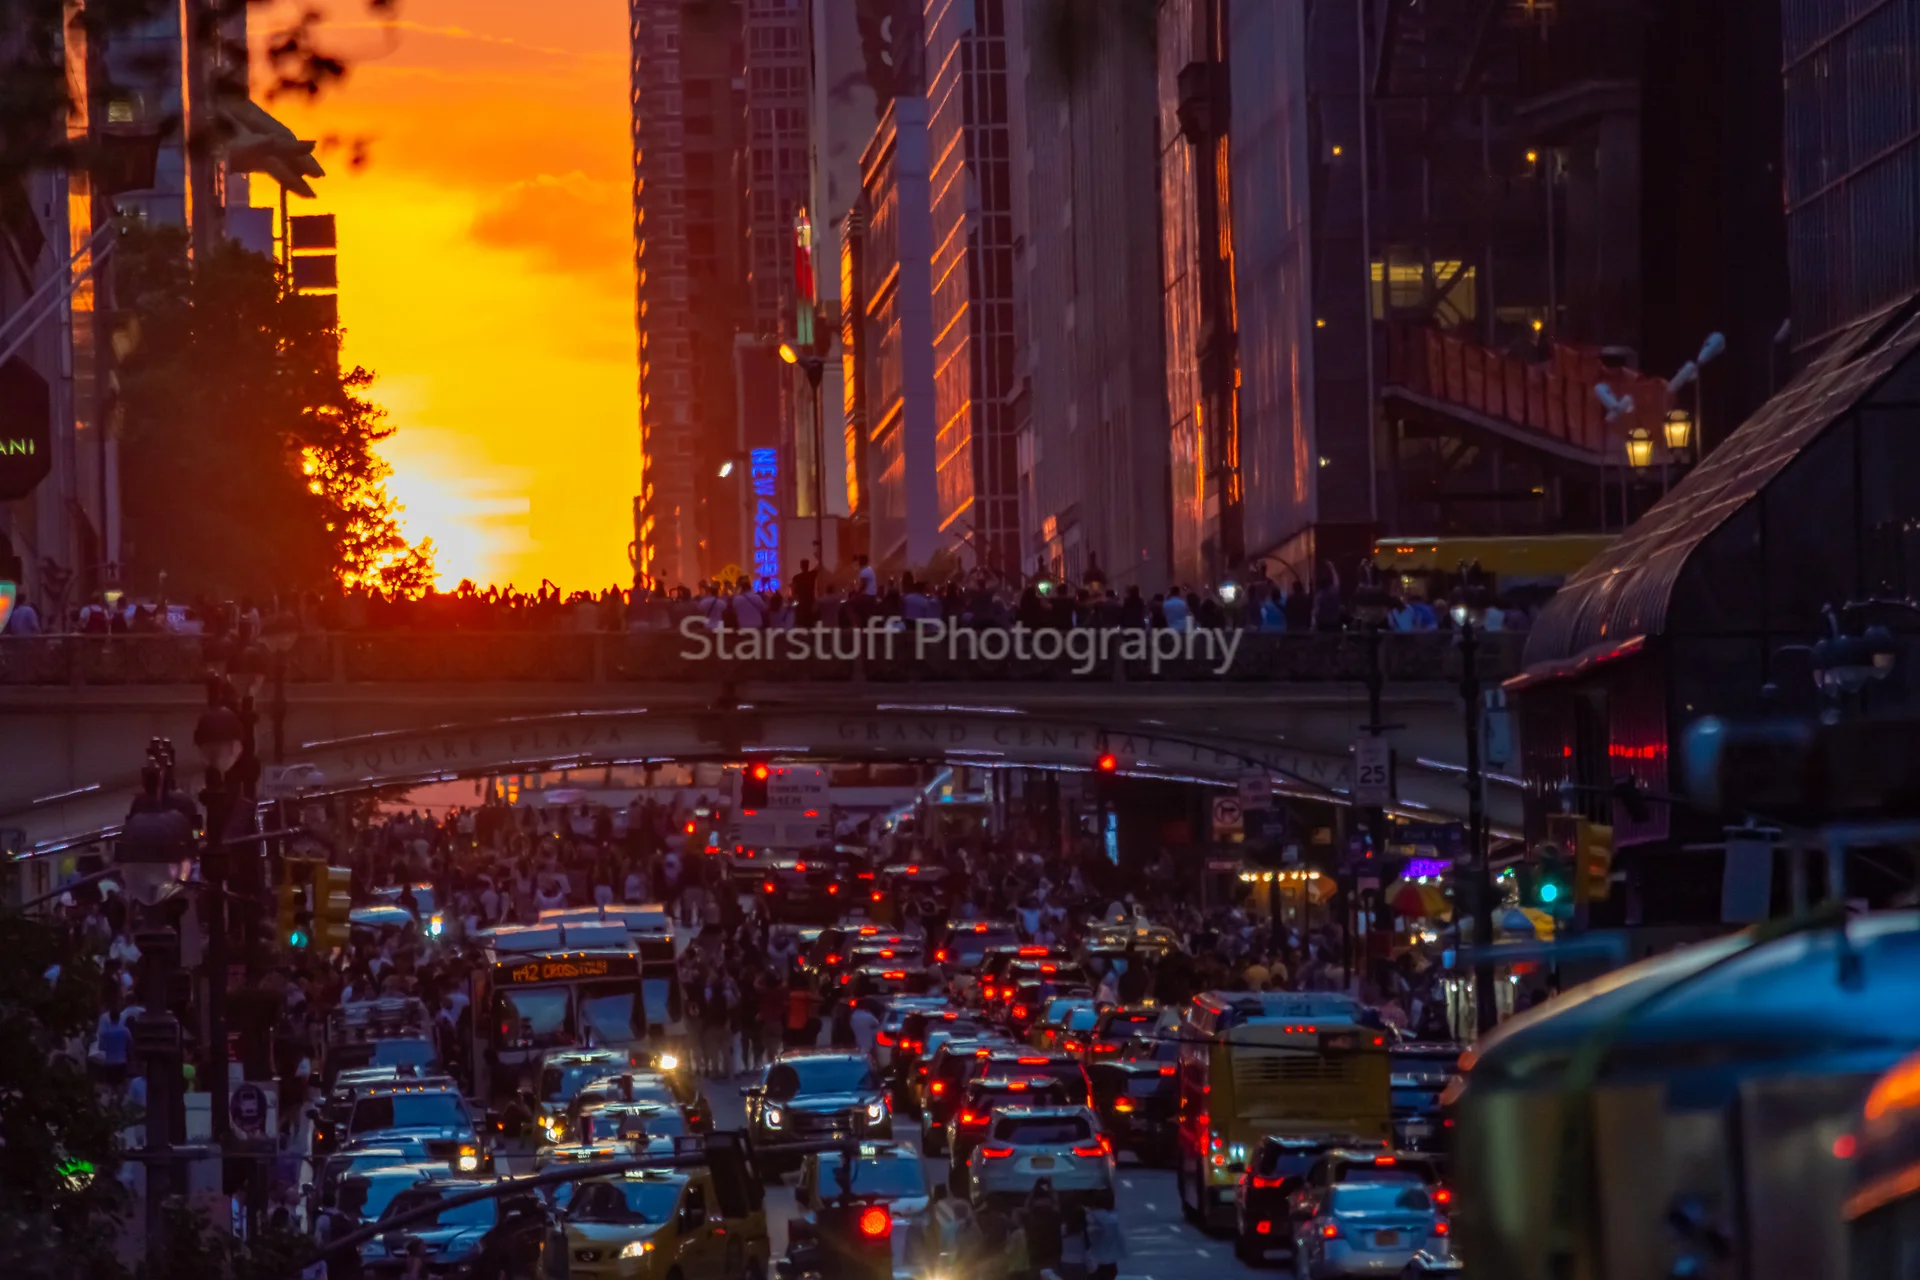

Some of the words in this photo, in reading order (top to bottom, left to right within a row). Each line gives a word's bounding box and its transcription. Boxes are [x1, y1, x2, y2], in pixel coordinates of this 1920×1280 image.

[751, 448, 777, 496] NEW
[754, 499, 778, 548] 42
[837, 721, 966, 743] GRAND
[342, 736, 483, 773] SQUARE
[509, 726, 622, 752] PLAZA
[1360, 765, 1386, 784] 25
[512, 963, 539, 982] M42
[542, 960, 608, 979] CROSSTOWN
